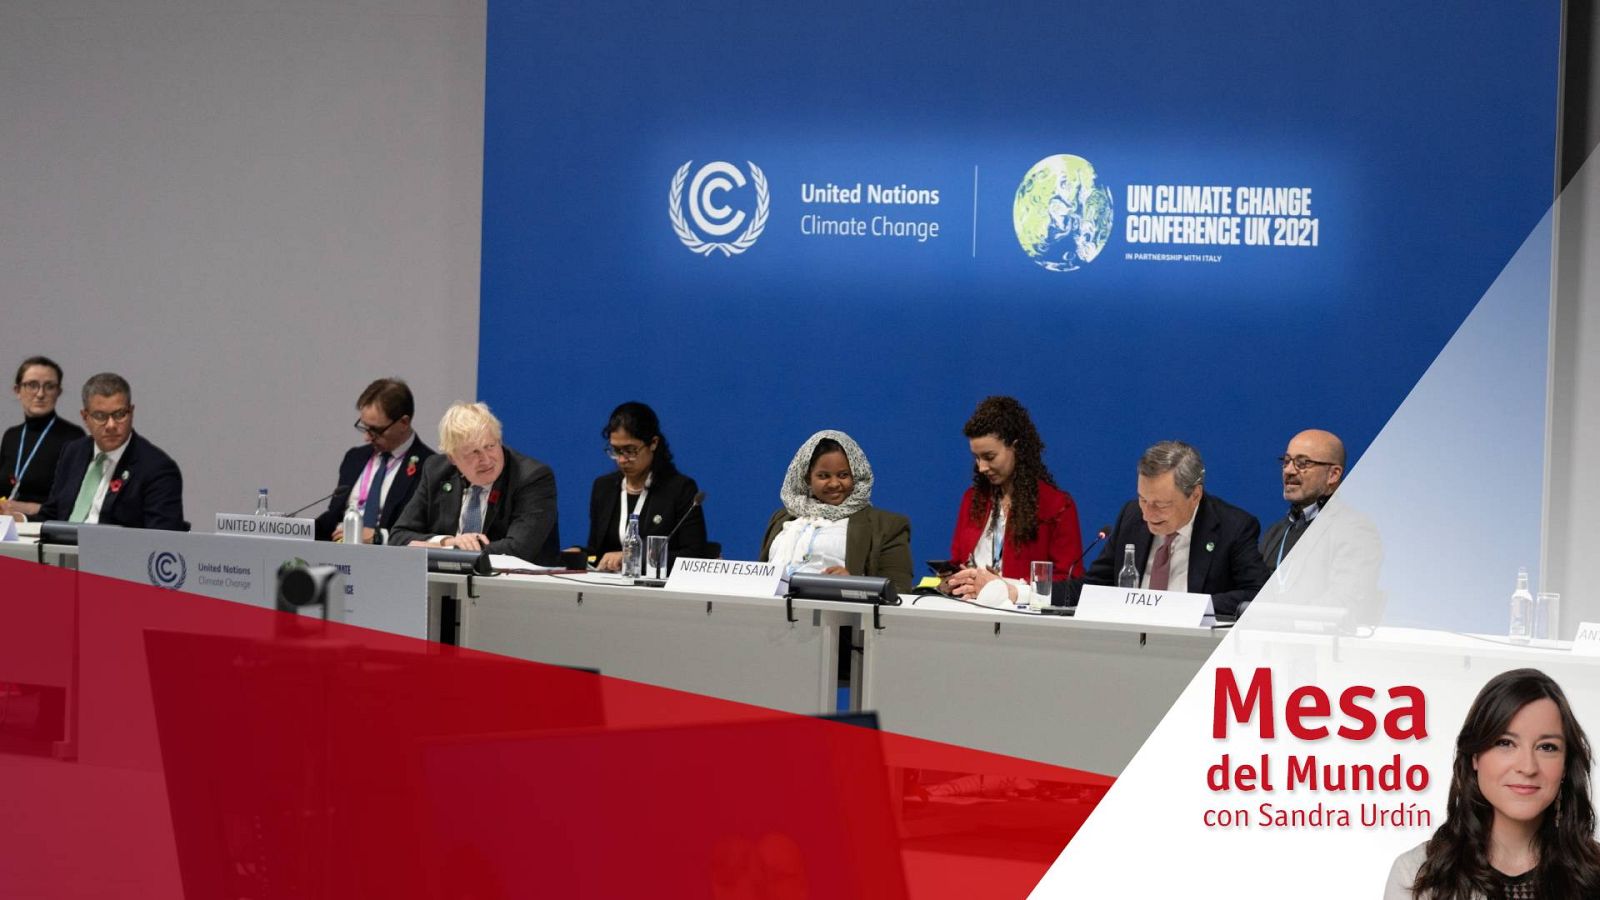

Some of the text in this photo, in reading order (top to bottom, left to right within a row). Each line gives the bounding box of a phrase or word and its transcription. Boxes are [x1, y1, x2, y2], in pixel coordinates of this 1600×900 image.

[801, 183, 939, 205] United Nations
[1127, 185, 1312, 216] UN CLIMATE CHANGE
[801, 214, 939, 242] Climate Change
[1126, 215, 1319, 246] CONFERENCE UK 2021
[1134, 253, 1183, 261] PARTNERSHIP
[1184, 254, 1201, 262] WITH
[217, 518, 311, 536] UNITED KINGDOM
[198, 563, 251, 575] United Nations
[680, 559, 776, 577] NISREEN ELSAIM
[1125, 592, 1163, 607] ITALY
